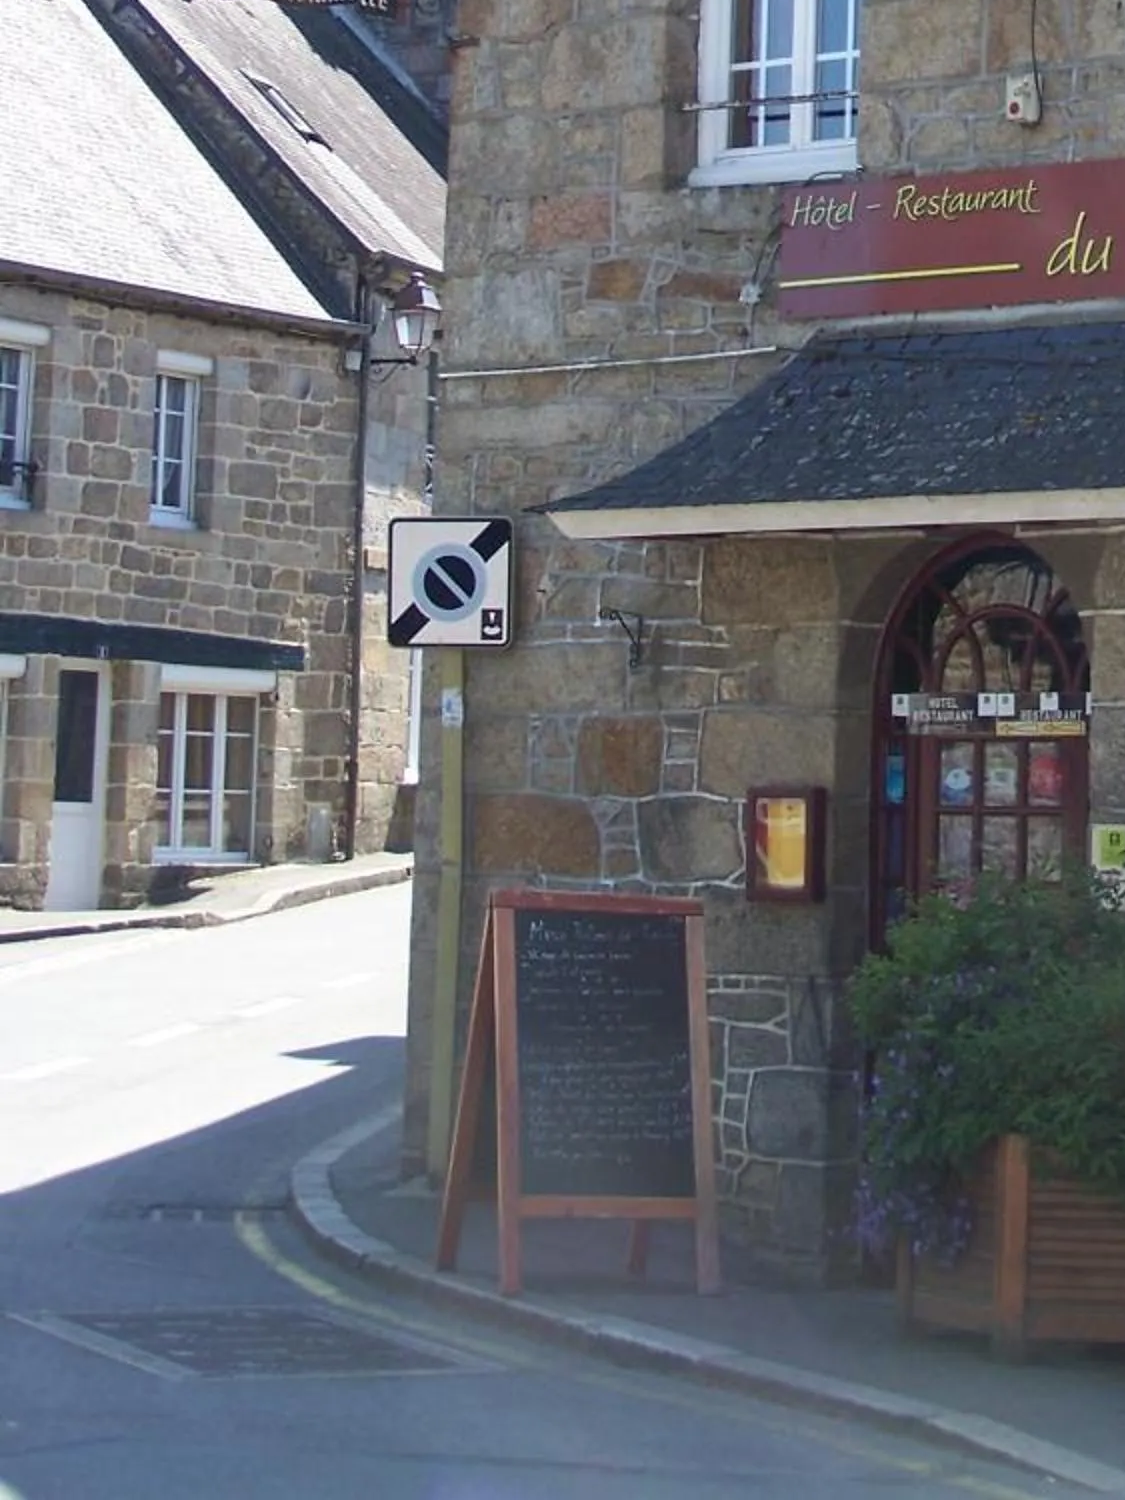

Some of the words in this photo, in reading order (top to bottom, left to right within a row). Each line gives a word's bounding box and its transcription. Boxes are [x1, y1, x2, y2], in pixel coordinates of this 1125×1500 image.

[790, 191, 858, 230] Hôtel
[892, 179, 1042, 222] Restaurant
[1045, 211, 1113, 277] du
